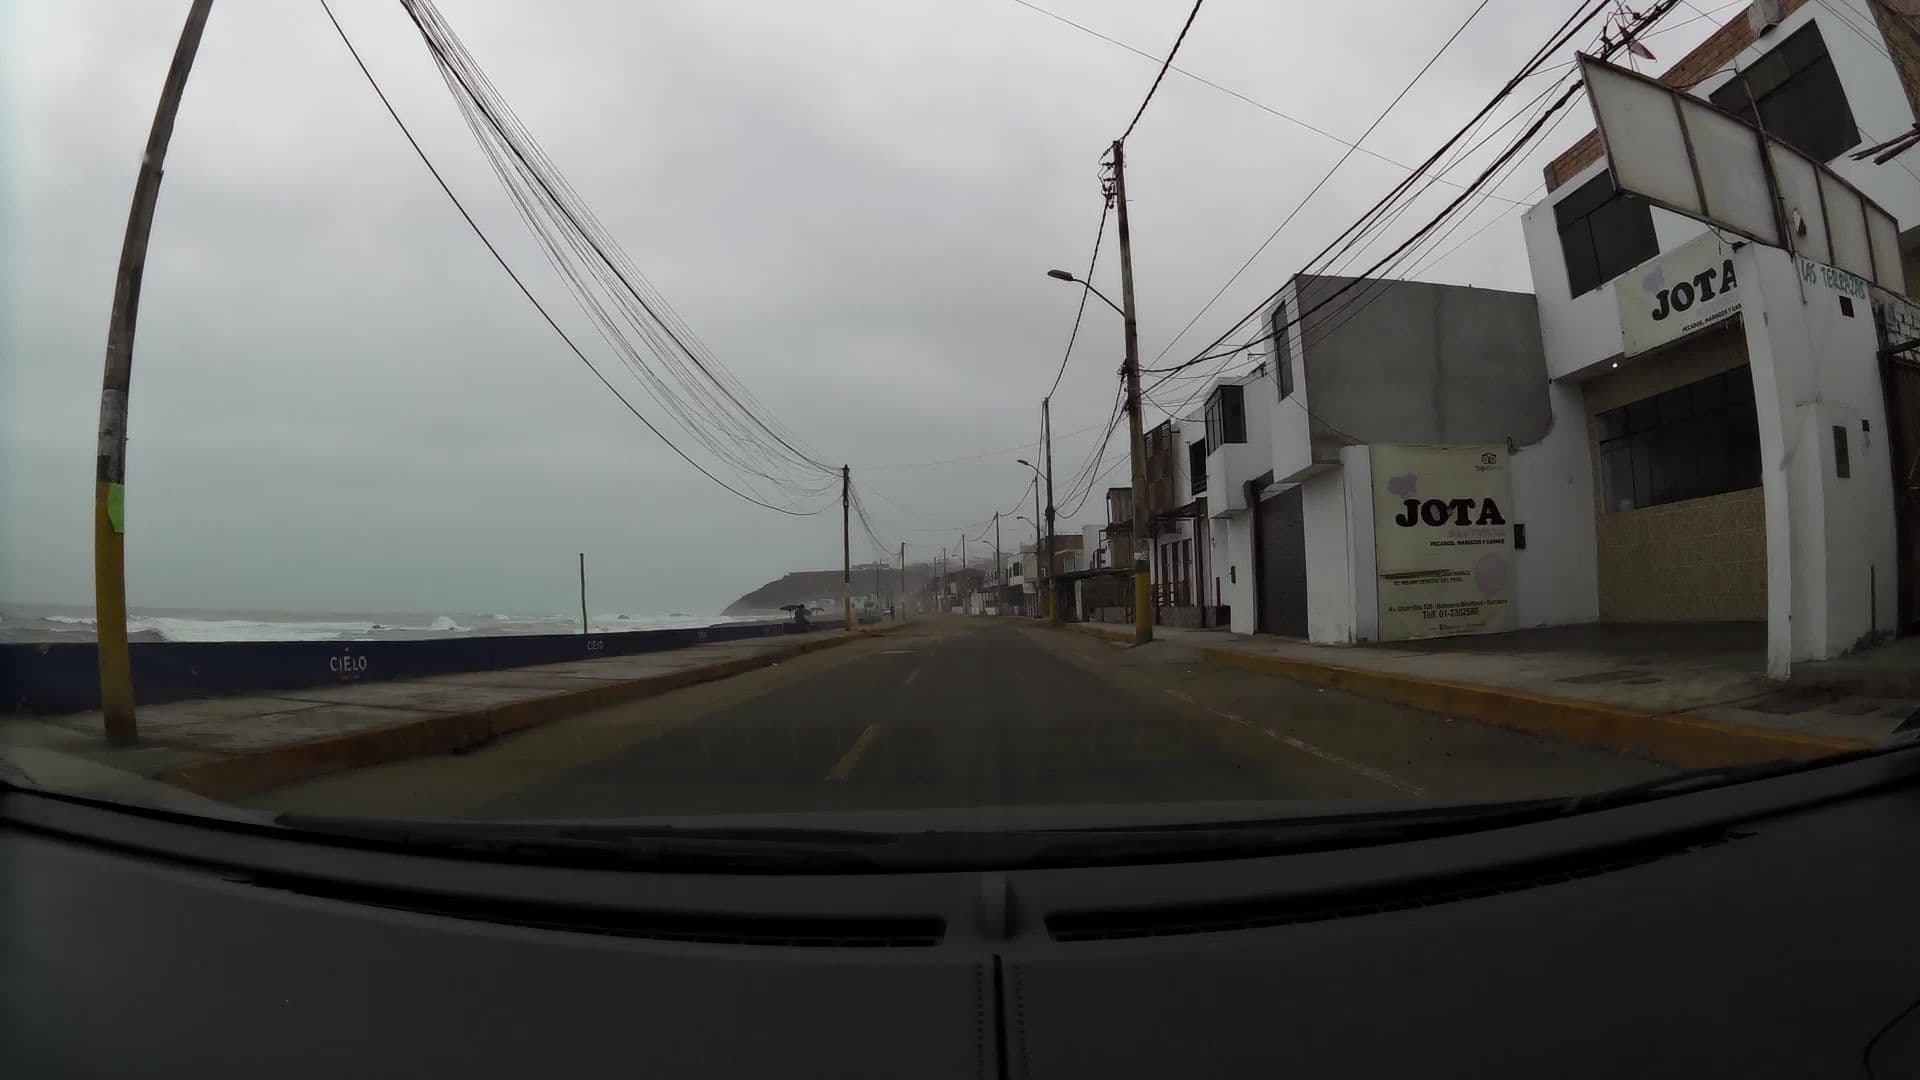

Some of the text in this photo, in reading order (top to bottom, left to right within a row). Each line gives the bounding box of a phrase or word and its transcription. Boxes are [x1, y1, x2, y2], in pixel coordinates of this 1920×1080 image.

[1652, 259, 1737, 320] JOTA
[1801, 259, 1866, 300] LAS TERRAZAS
[1395, 498, 1505, 527] JOTA
[330, 655, 367, 671] CIELO
